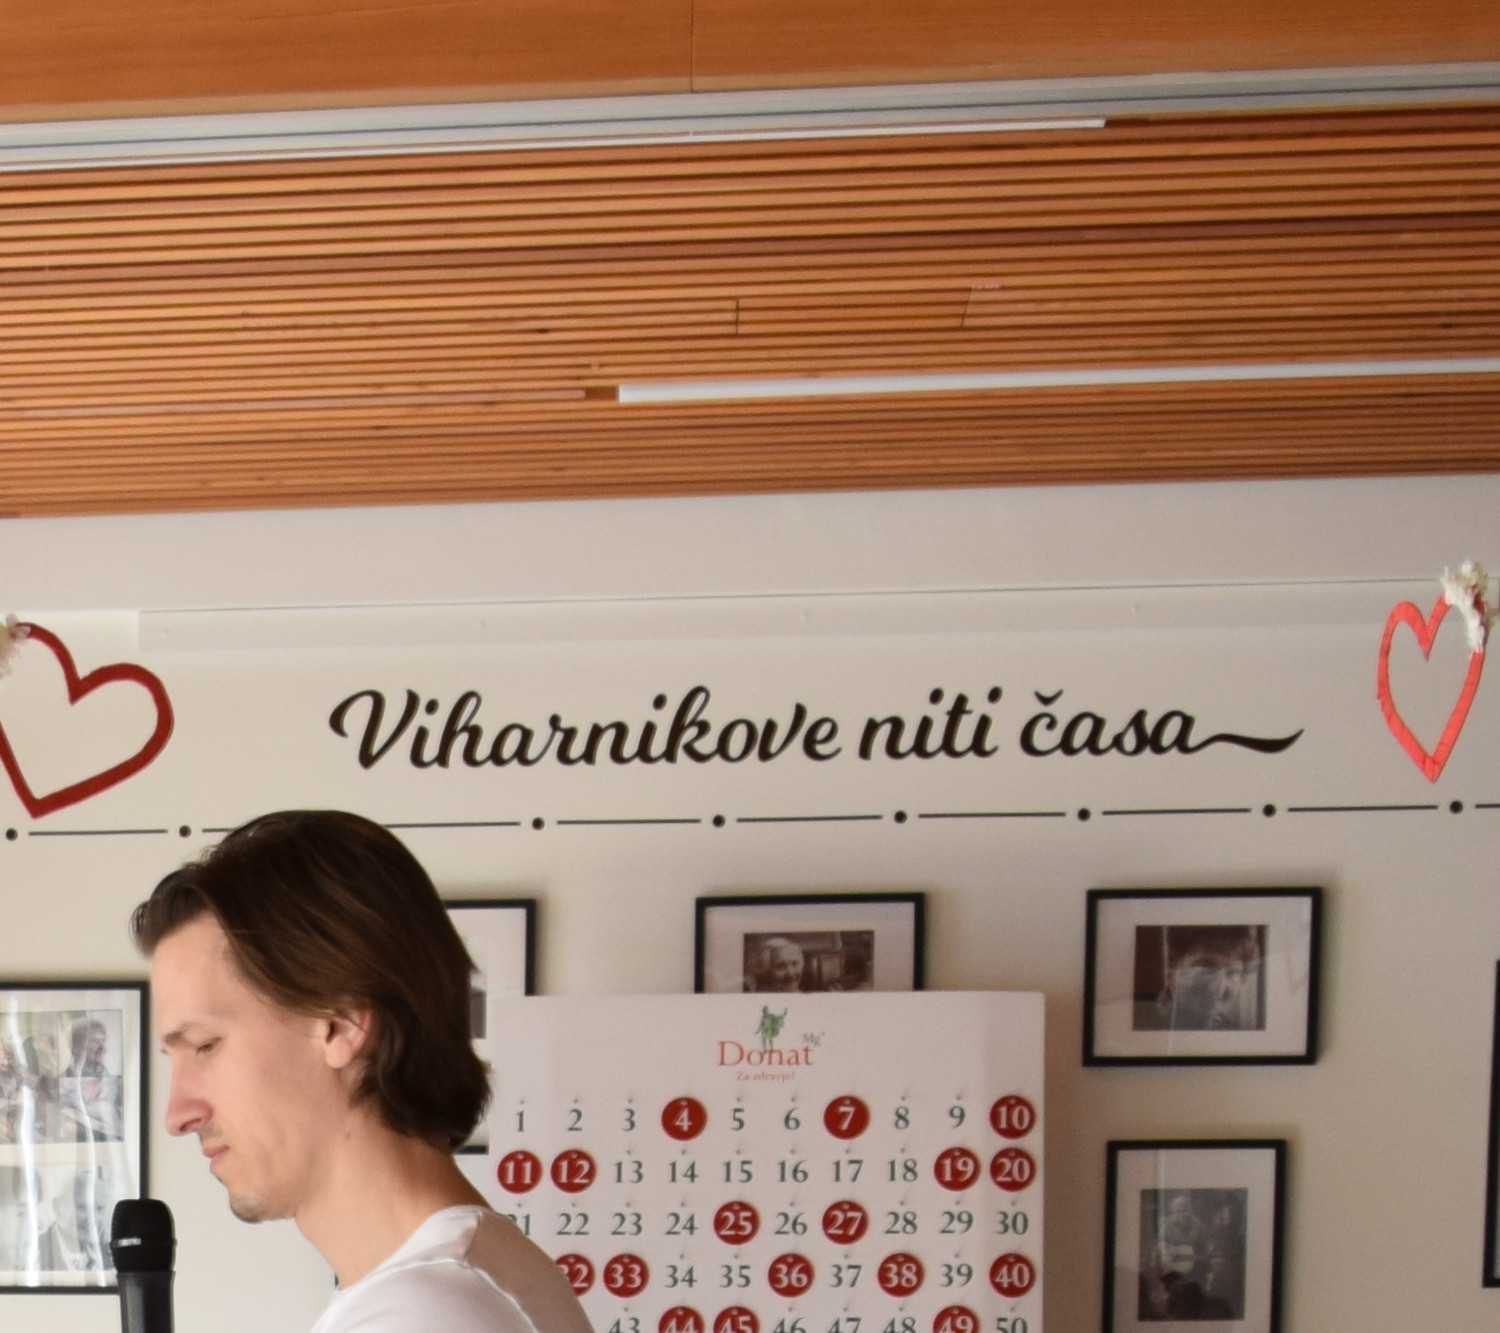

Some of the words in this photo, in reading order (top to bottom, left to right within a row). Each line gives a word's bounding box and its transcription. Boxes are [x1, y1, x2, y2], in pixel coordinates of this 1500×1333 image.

[328, 685, 843, 770] Viharnikove
[858, 686, 1003, 760] niti
[1019, 689, 1304, 757] časa
[718, 1040, 814, 1067] Donat
[735, 1070, 750, 1081] Za
[514, 1109, 525, 1132] 1
[566, 1108, 583, 1132] 2
[622, 1109, 635, 1132] 3
[674, 1108, 692, 1131] 4
[730, 1107, 745, 1131] 5
[782, 1108, 801, 1130] 6
[837, 1106, 855, 1130] 7
[893, 1106, 910, 1130] 8
[947, 1105, 966, 1128] 9
[999, 1106, 1030, 1129] 10
[503, 1161, 532, 1184] 11
[560, 1160, 589, 1183] 12
[614, 1160, 644, 1184] 13
[668, 1161, 699, 1184] 14
[723, 1159, 753, 1183] 15
[777, 1160, 809, 1183] 16
[832, 1159, 864, 1183] 17
[888, 1158, 918, 1182] 18
[942, 1157, 975, 1181] 19
[996, 1158, 1030, 1181] 20
[555, 1212, 589, 1236] 22
[609, 1212, 643, 1236] 23
[664, 1212, 698, 1236] 24
[718, 1211, 753, 1235] 25
[773, 1211, 808, 1235] 26
[826, 1210, 863, 1236] 27
[883, 1211, 918, 1235] 28
[938, 1210, 974, 1234] 29
[997, 1211, 1029, 1235] 30
[608, 1264, 641, 1287] 33
[665, 1264, 698, 1288] 34
[721, 1264, 751, 1288] 35
[775, 1263, 808, 1288] 36
[831, 1264, 862, 1288] 37
[885, 1263, 918, 1288] 38
[942, 1263, 973, 1288] 39
[994, 1263, 1030, 1288] 40
